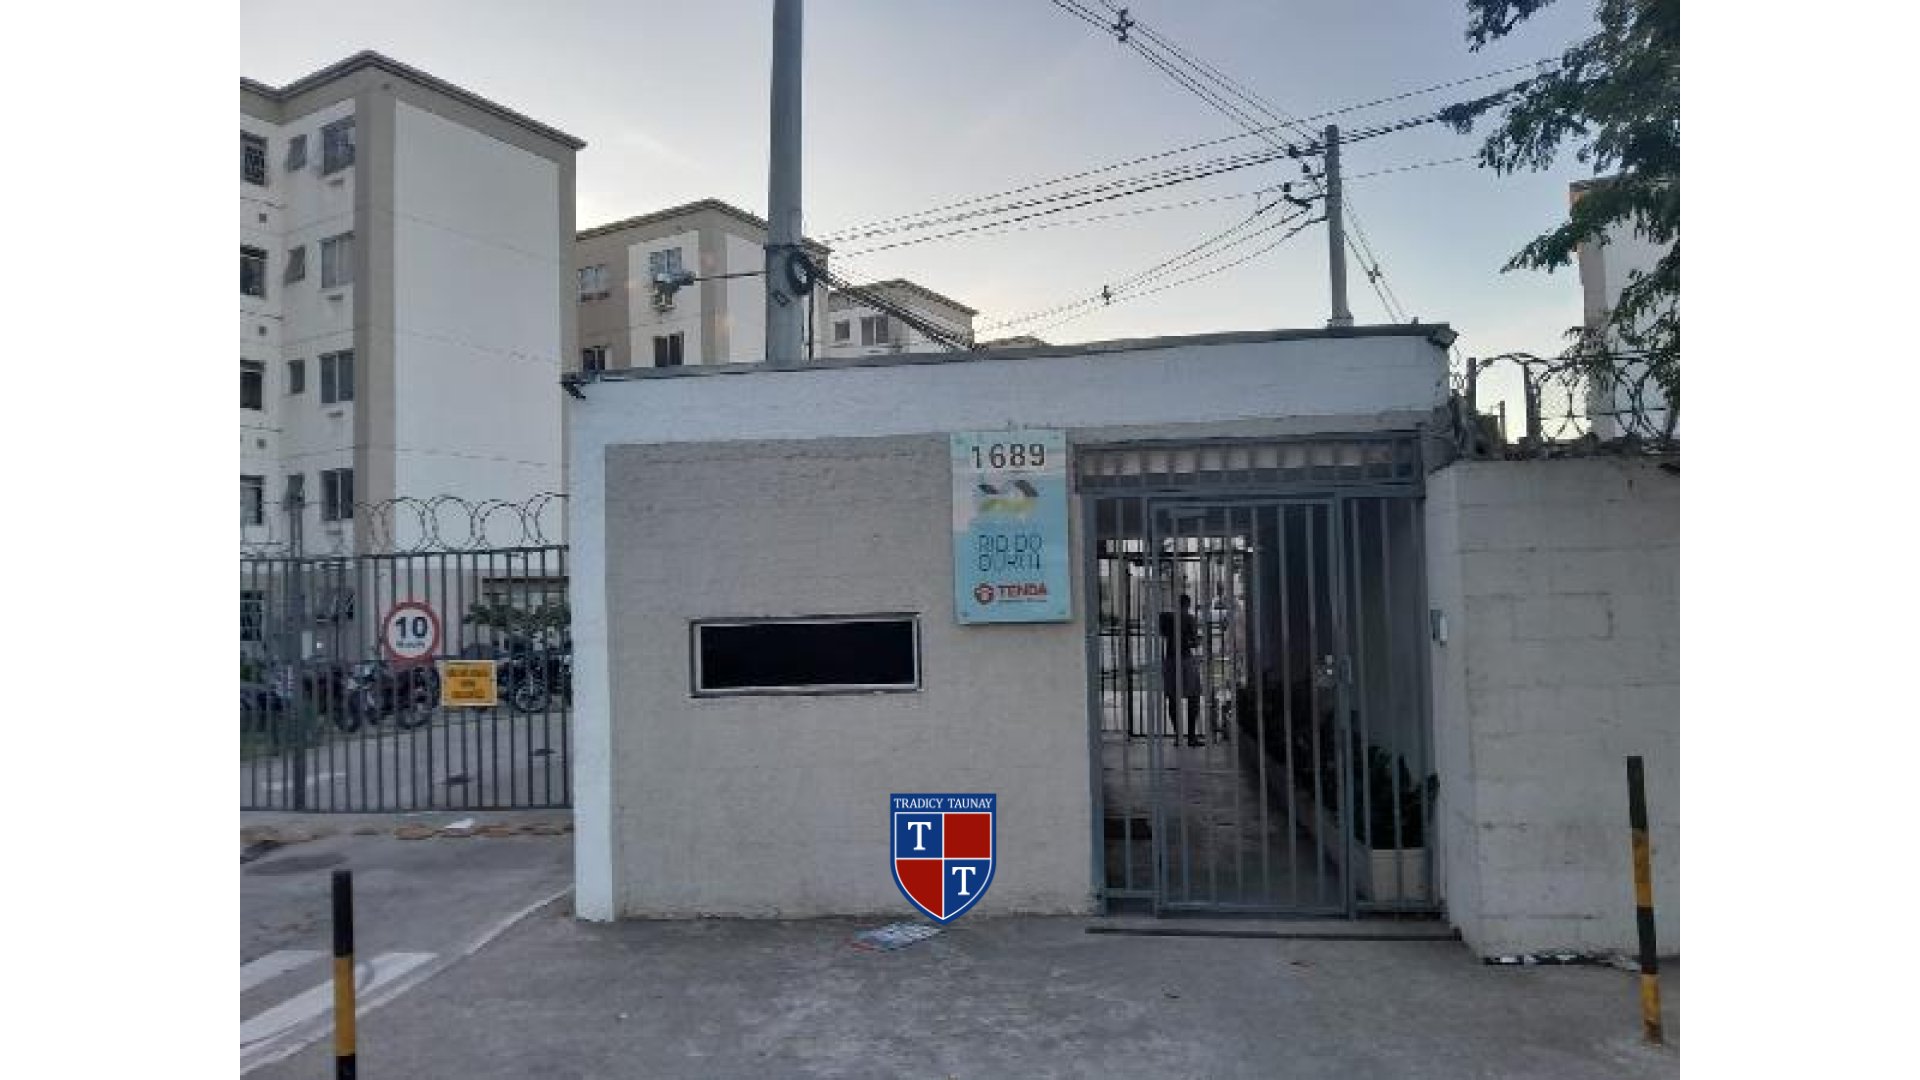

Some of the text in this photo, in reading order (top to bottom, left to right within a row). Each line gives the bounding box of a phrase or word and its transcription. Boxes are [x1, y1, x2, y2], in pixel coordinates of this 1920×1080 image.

[972, 443, 1045, 469] 1689
[997, 582, 1047, 599] TENDA
[396, 616, 428, 639] 10
